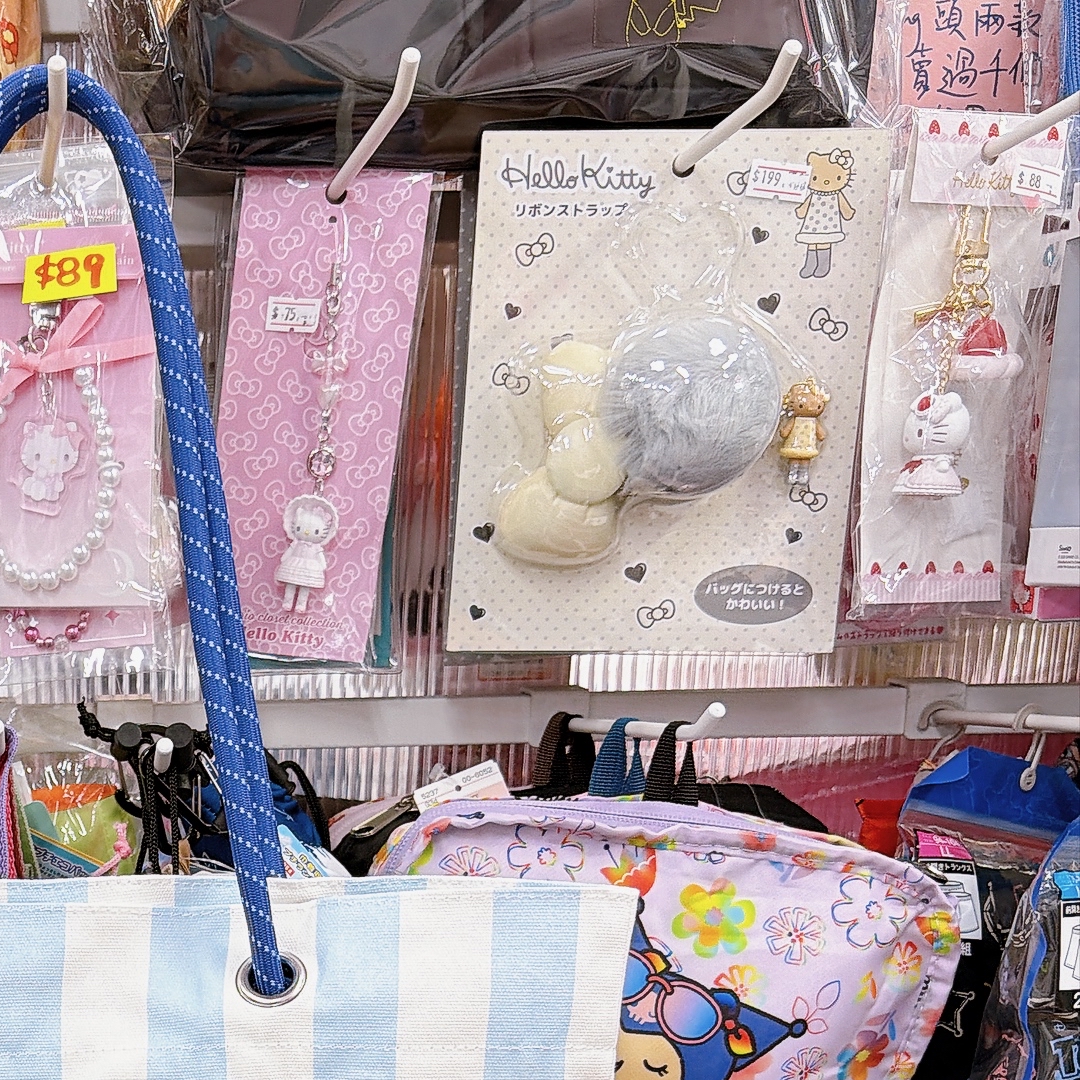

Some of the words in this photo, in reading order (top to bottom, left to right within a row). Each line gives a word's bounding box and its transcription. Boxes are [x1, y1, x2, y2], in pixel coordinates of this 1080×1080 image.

[501, 153, 579, 191] Hello
[581, 156, 657, 199] Kitty
[988, 171, 1013, 190] Kitt
[515, 202, 630, 218] リボンストラップ
[35, 253, 105, 290] $89
[705, 582, 804, 597] バッグにつけると
[258, 612, 289, 624] closet
[291, 614, 343, 630] collection
[244, 626, 277, 641] ello
[281, 629, 324, 648] Kitty
